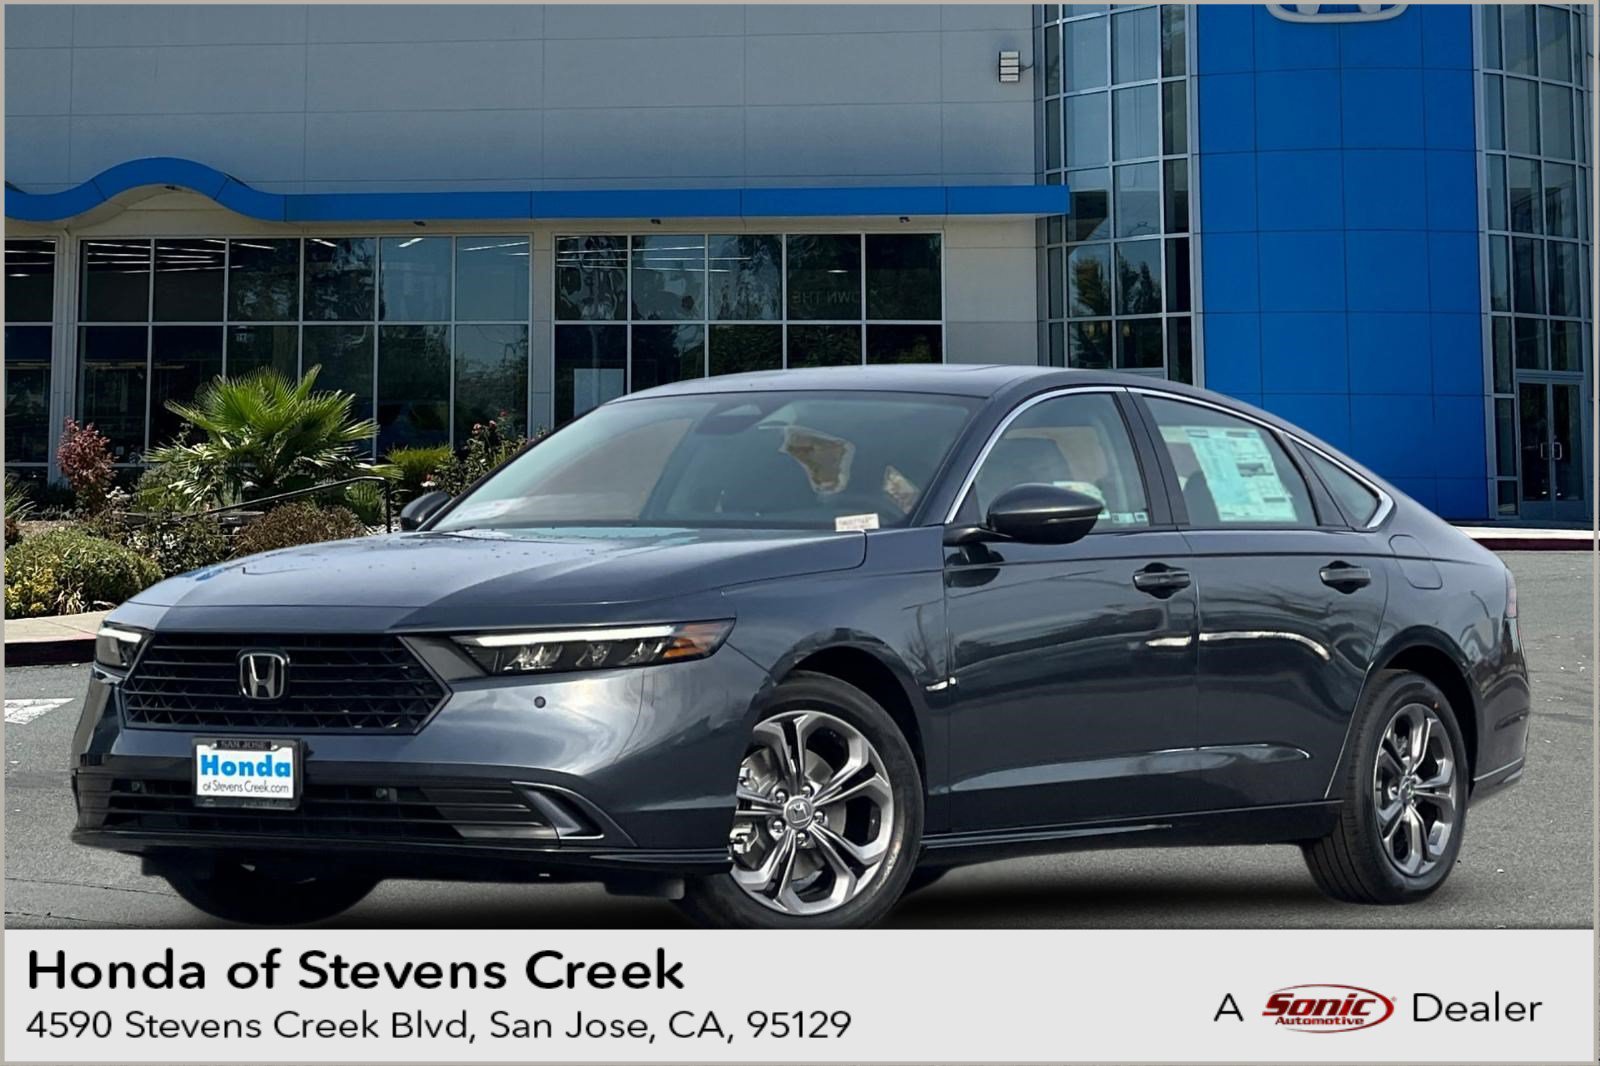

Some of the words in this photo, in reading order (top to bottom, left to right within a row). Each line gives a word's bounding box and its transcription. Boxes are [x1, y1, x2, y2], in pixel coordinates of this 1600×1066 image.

[221, 740, 241, 750] SAN
[243, 741, 266, 750] JOSE
[200, 754, 291, 777] Honda
